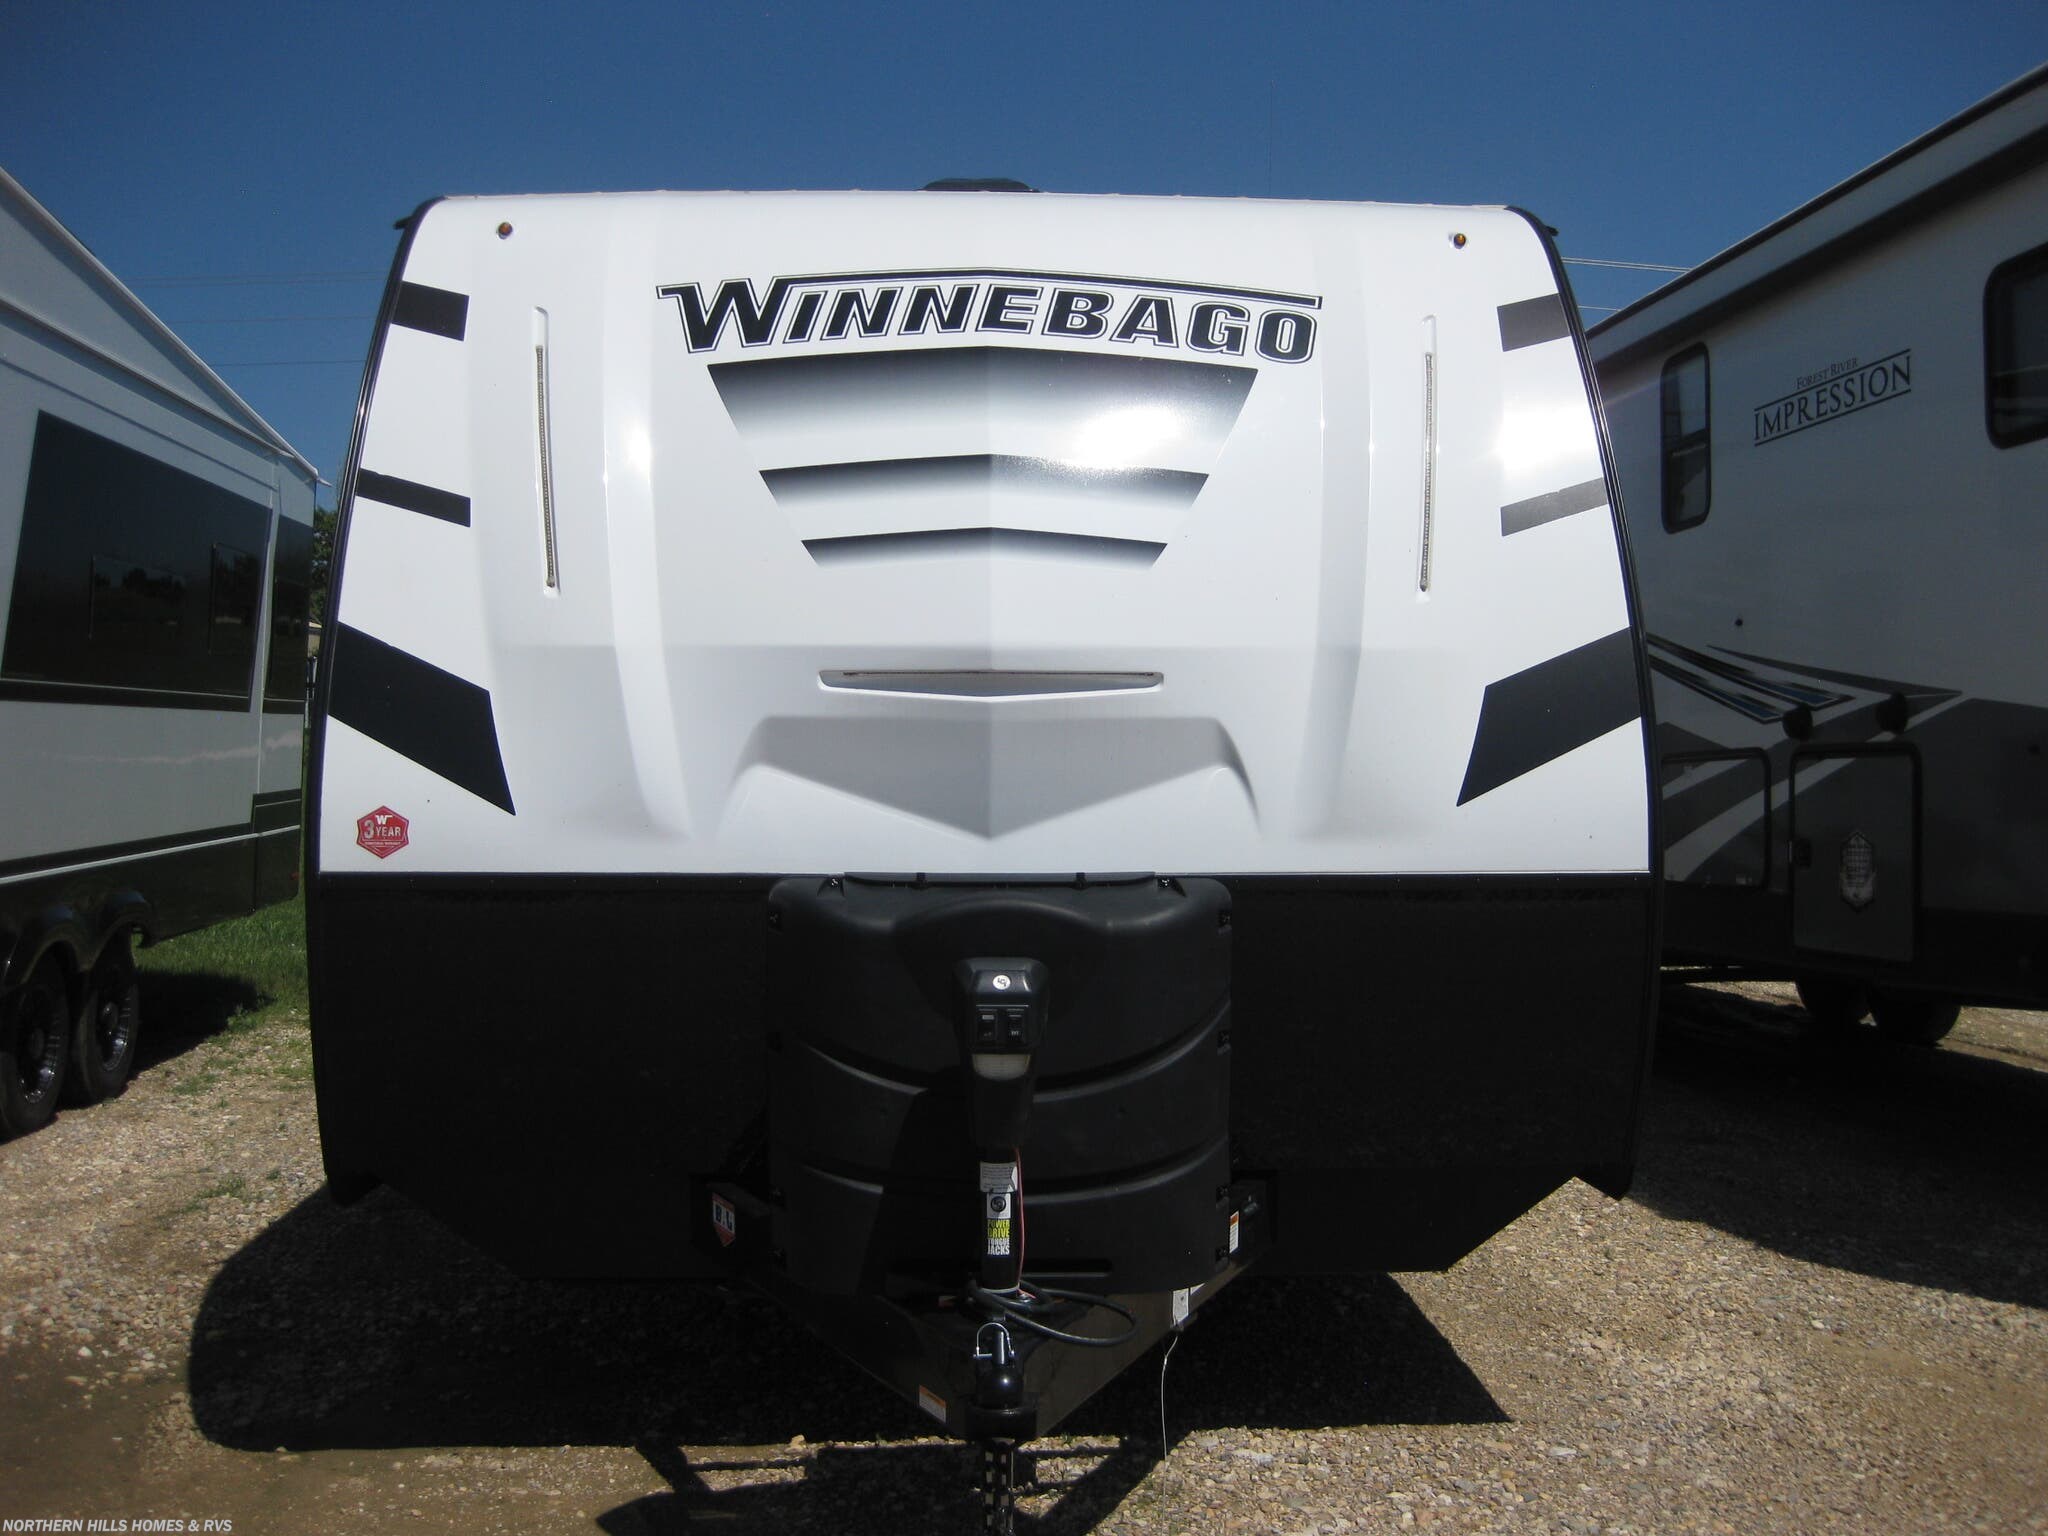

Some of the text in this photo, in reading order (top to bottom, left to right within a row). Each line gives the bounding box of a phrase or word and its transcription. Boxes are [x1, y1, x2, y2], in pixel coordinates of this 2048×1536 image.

[656, 267, 1323, 364] WINNEBAGO
[1796, 358, 1859, 389] FOREST RIVER
[1755, 356, 1911, 440] IMPRESSION
[364, 819, 401, 839] 3 YEAR
[988, 1219, 1010, 1228] POWER
[988, 1228, 1010, 1238] DRIVE
[988, 1245, 1010, 1255] JACKS
